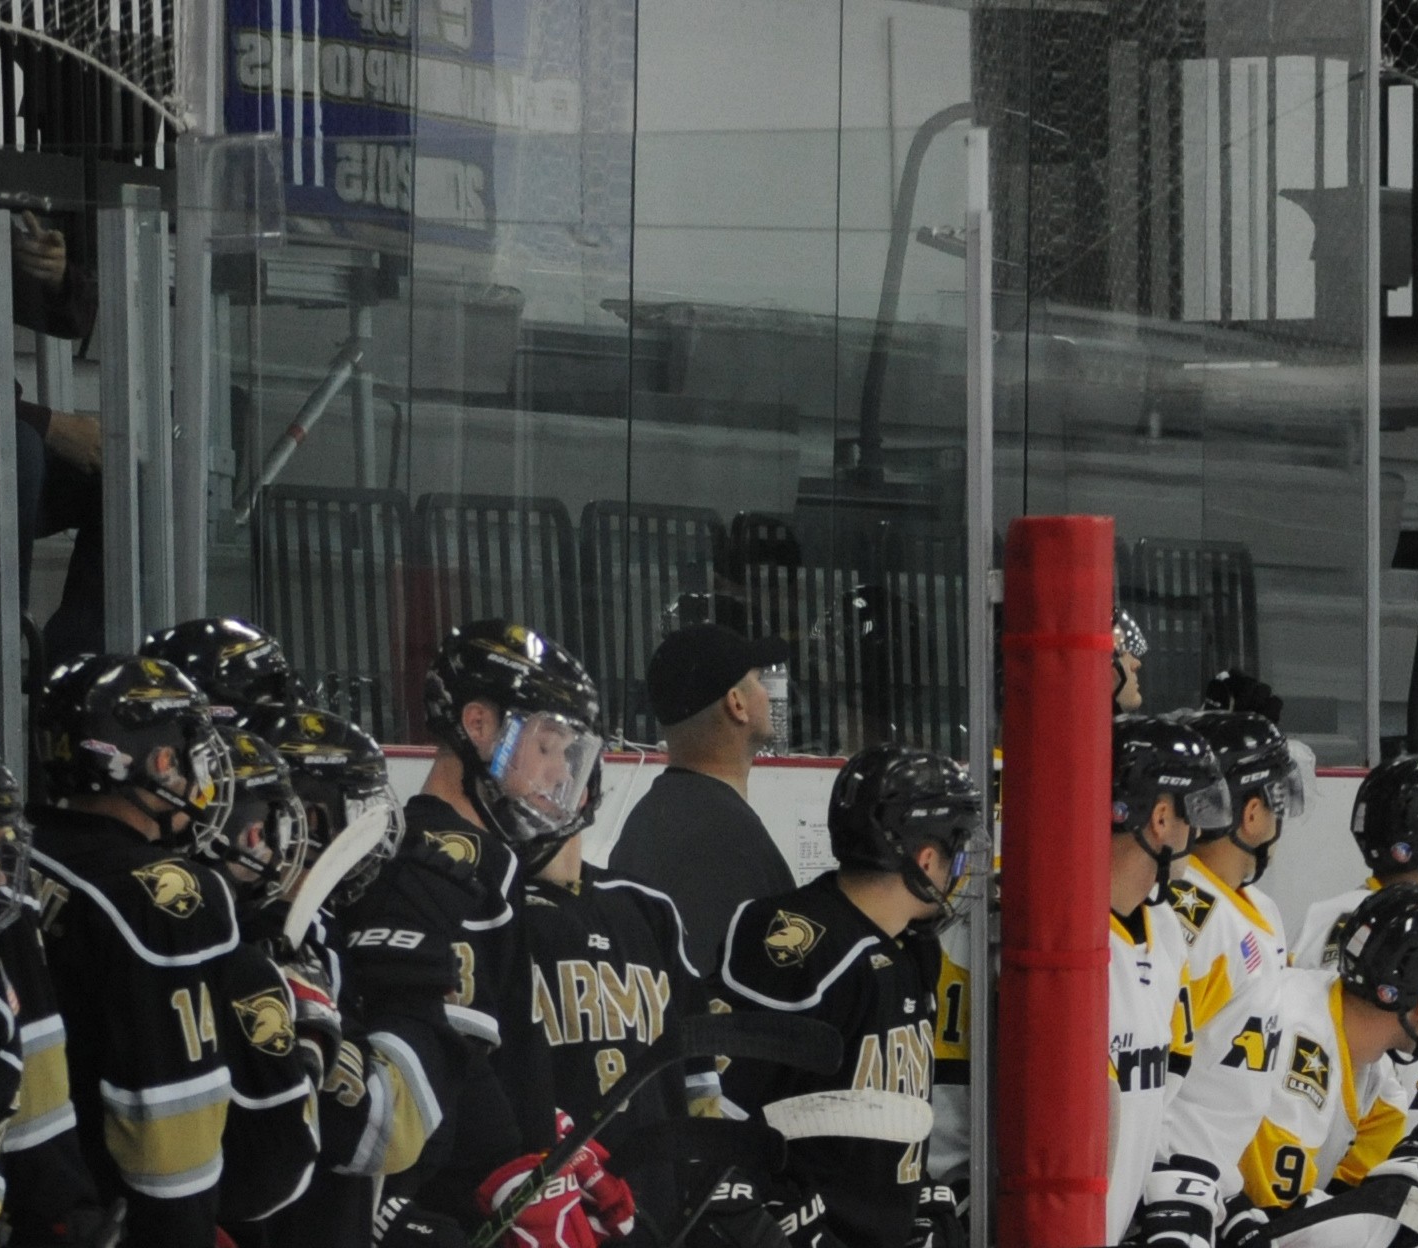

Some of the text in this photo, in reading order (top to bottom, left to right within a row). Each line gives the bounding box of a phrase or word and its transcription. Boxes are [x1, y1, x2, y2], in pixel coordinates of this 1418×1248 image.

[1158, 775, 1192, 786] CCM
[531, 959, 670, 1047] ARMY
[1272, 1145, 1306, 1201] 9
